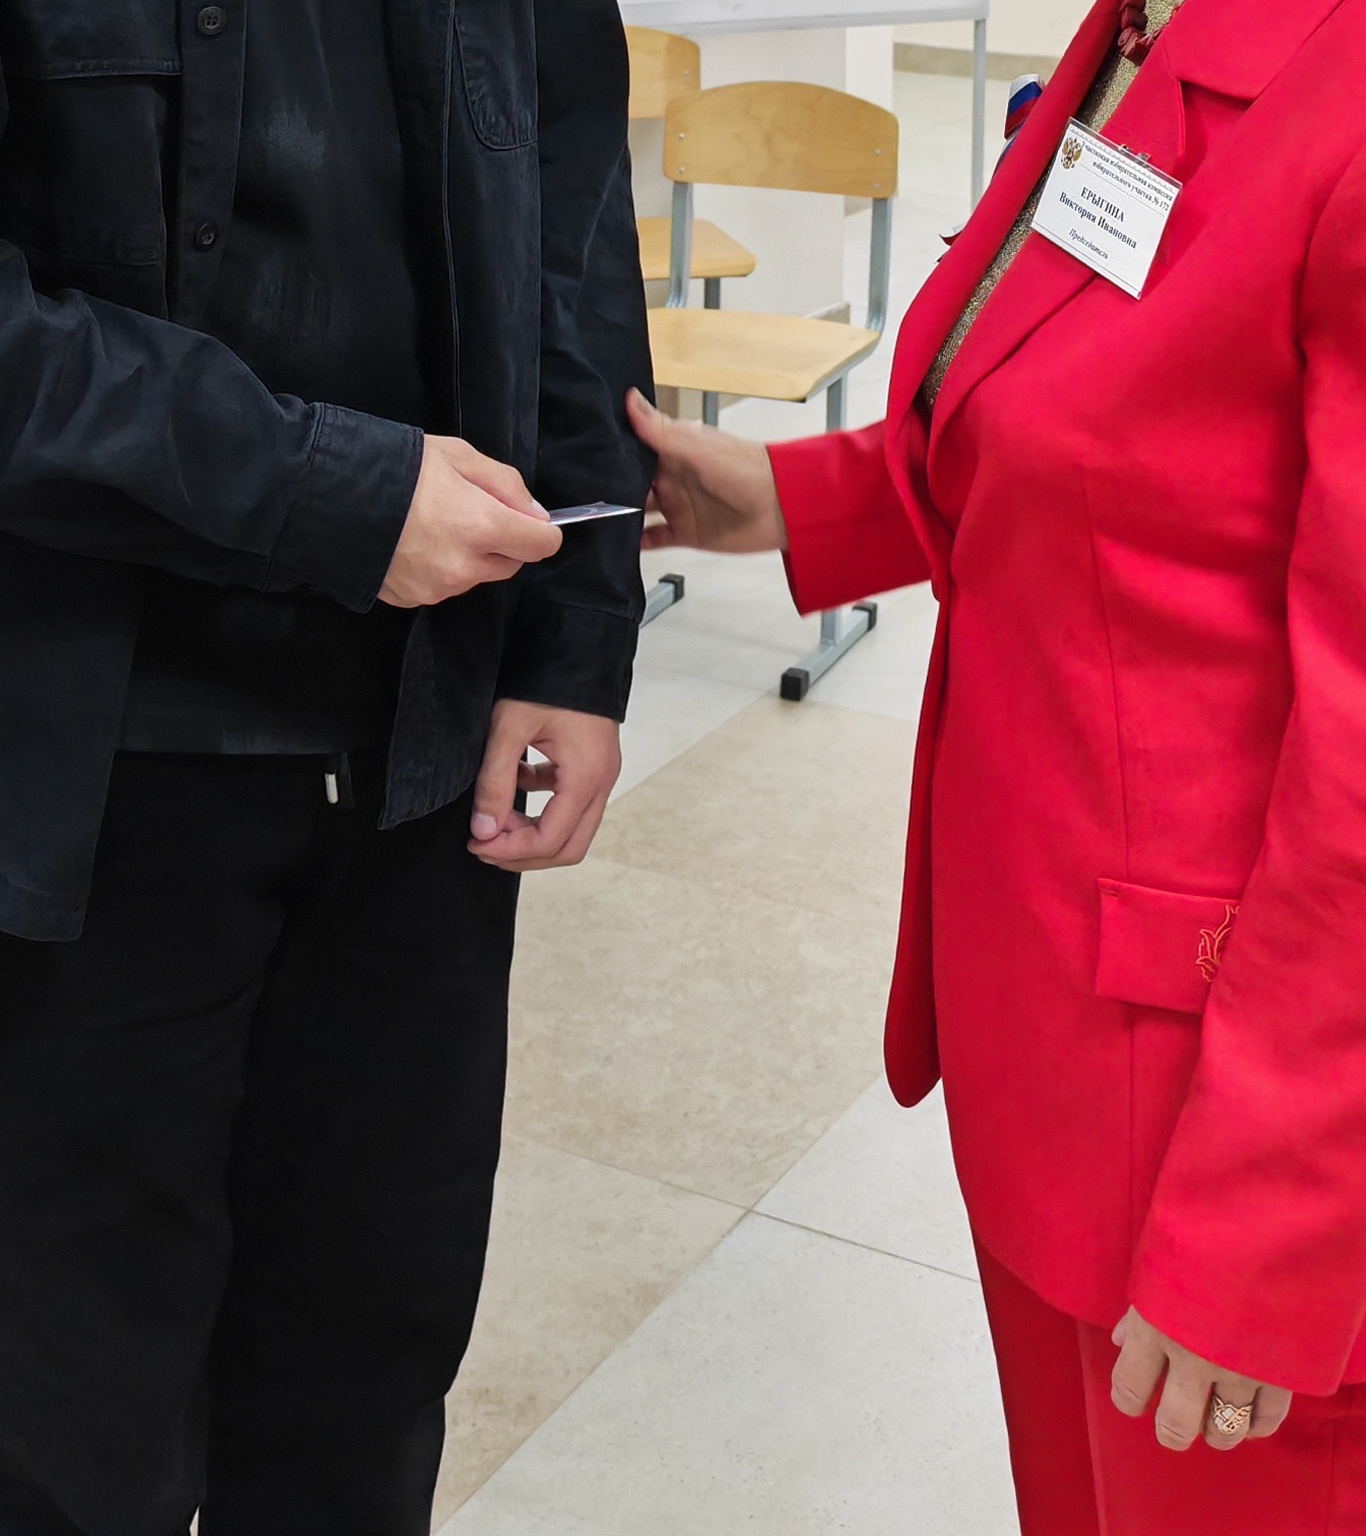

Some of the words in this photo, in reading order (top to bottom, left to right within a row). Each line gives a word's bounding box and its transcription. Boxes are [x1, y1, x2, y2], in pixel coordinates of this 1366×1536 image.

[1059, 191, 1097, 223] Виктория
[1097, 216, 1138, 249] Ивановна
[1080, 186, 1125, 222] ЕРЫГИНА
